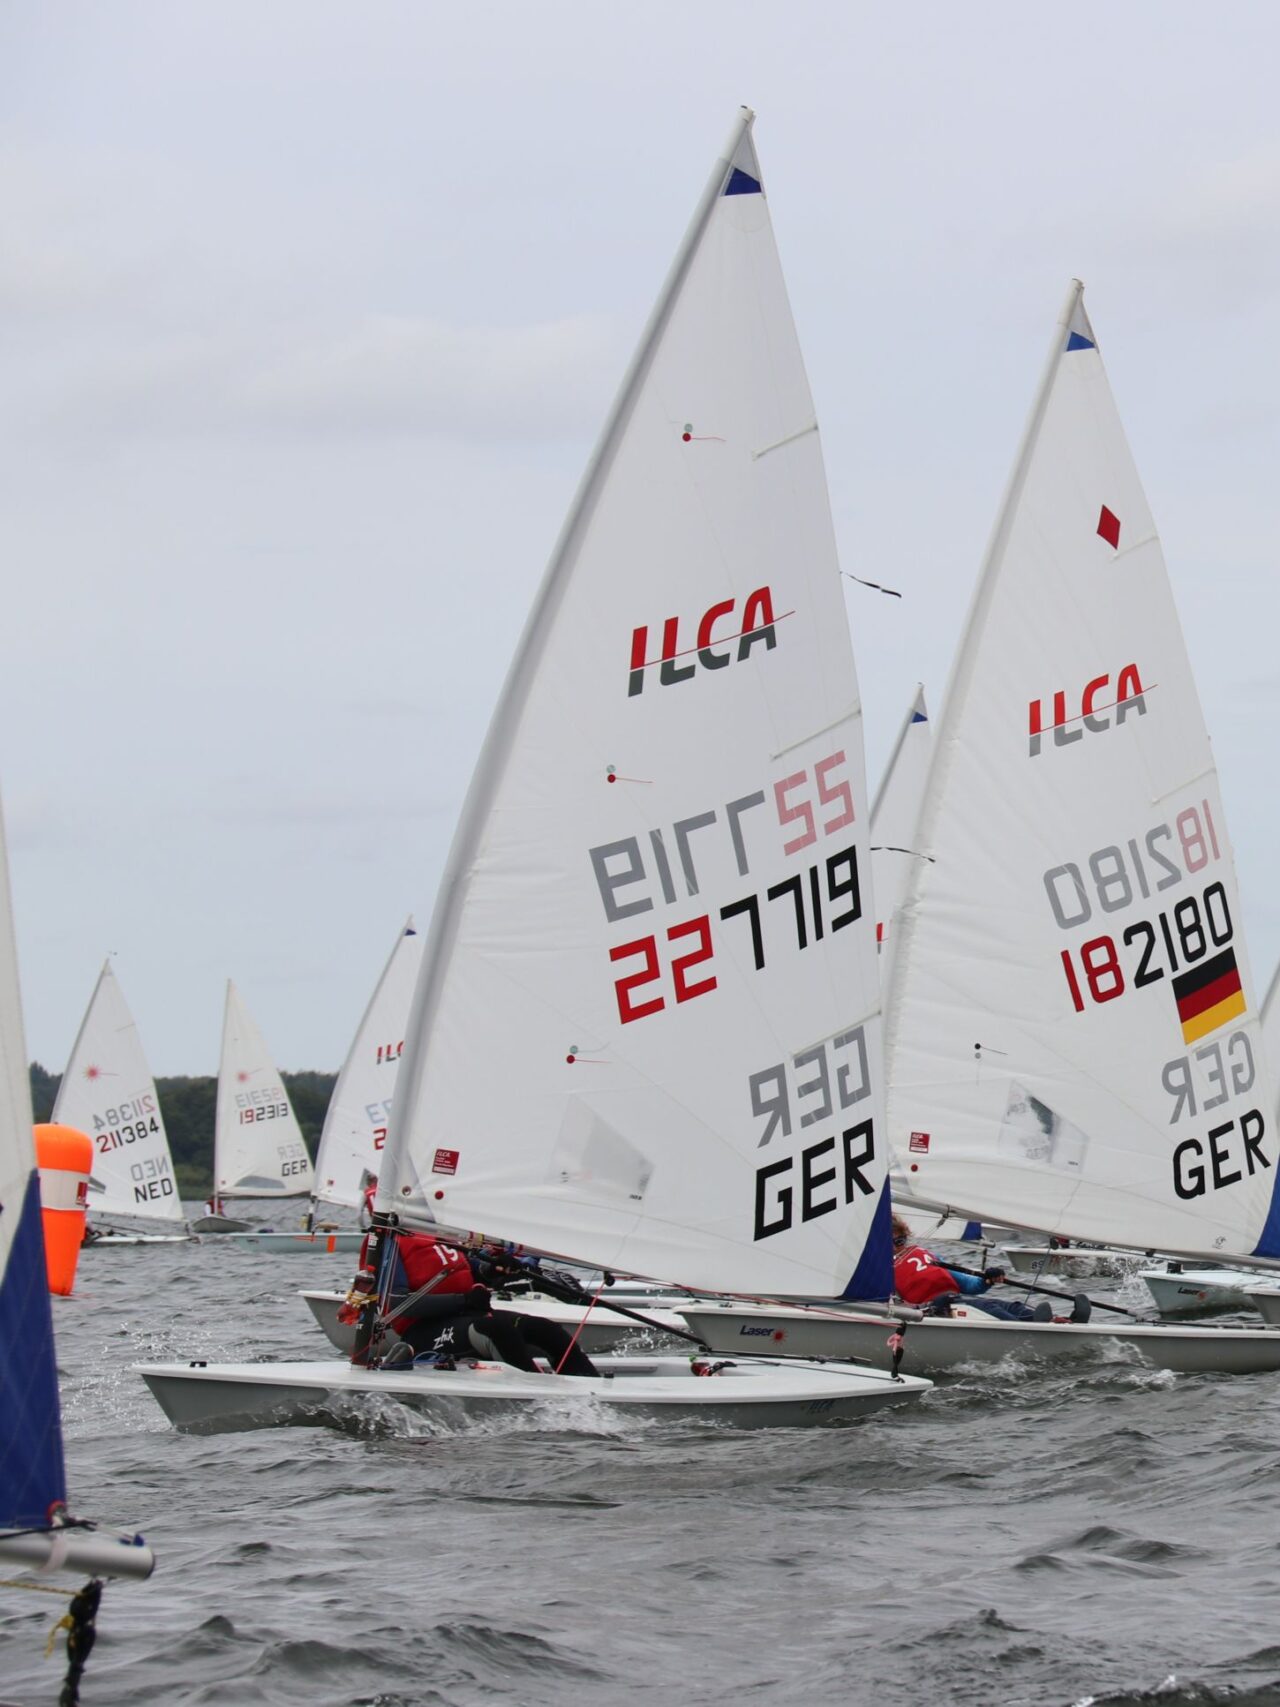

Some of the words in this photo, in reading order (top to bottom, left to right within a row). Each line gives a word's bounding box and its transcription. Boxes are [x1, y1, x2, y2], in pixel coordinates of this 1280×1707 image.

[628, 586, 777, 697] ILCA
[1029, 663, 1148, 757] ILCA
[609, 845, 862, 1025] 227719
[1060, 881, 1234, 1013] 182180
[96, 1116, 159, 1153] 211384
[240, 1102, 288, 1125] 192313
[1173, 1108, 1272, 1200] GER
[134, 1178, 173, 1203] NED
[282, 1159, 308, 1177] GER
[754, 1118, 875, 1241] GER
[740, 1325, 775, 1336] Laser
